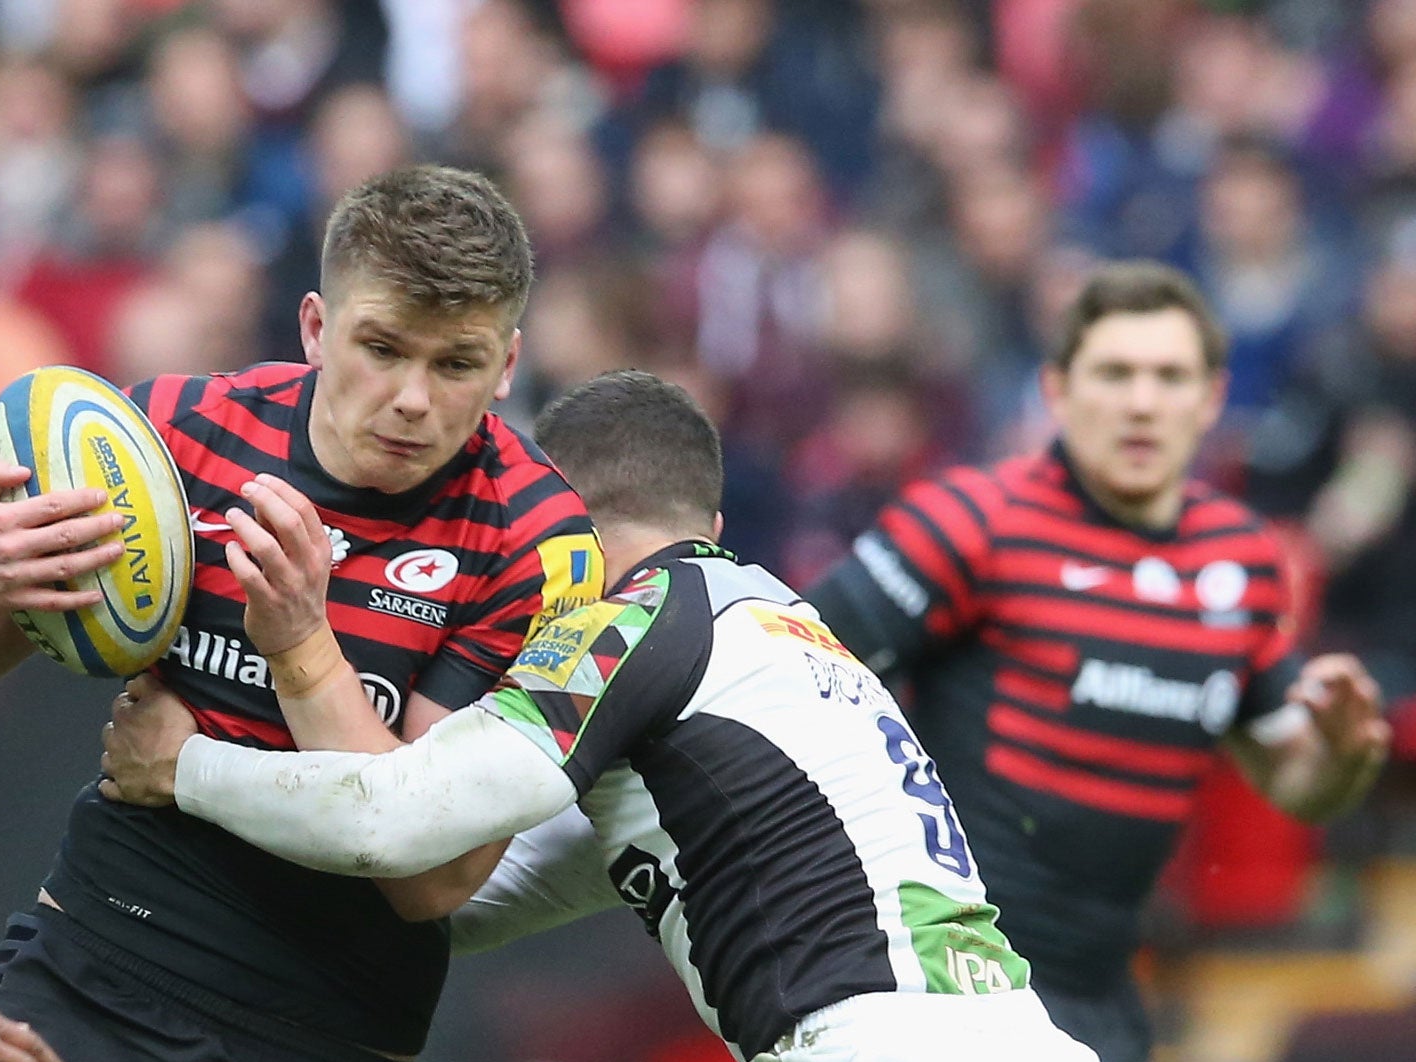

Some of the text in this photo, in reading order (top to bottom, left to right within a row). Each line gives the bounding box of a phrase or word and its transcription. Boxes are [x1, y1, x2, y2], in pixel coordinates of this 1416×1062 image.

[94, 435, 126, 487] RUGBY
[112, 487, 151, 584] AVIVA
[162, 625, 278, 691] Allia
[876, 714, 972, 879] 9
[944, 945, 1013, 996] IPA
